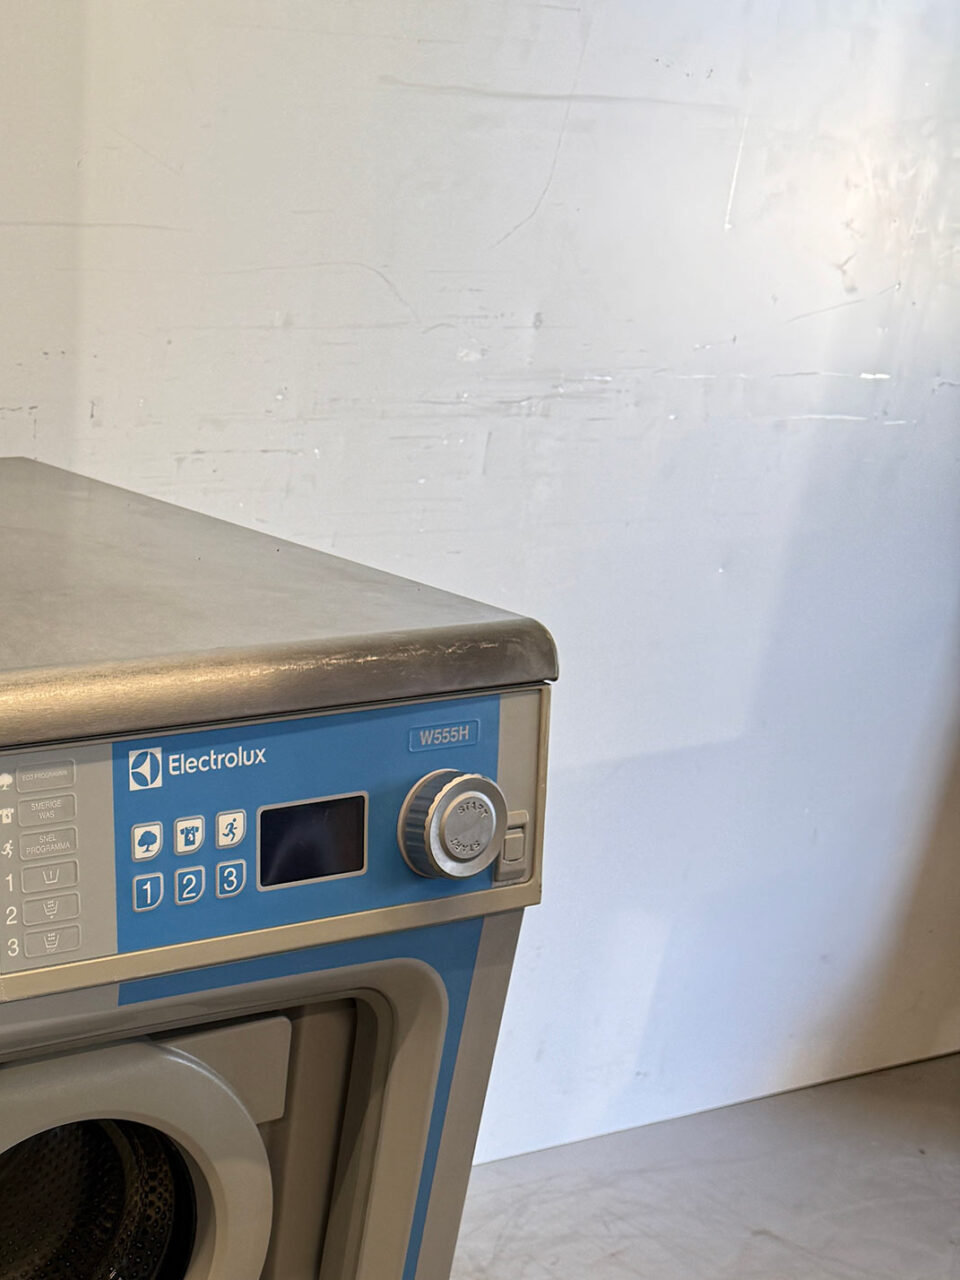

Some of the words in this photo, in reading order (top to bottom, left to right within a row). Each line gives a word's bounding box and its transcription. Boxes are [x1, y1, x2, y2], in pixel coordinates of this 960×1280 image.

[419, 724, 470, 747] W555H
[168, 745, 267, 777] Electrolux
[30, 799, 62, 811] SMERIGE
[457, 800, 489, 818] START
[38, 810, 55, 820] WAS
[25, 841, 71, 855] PROGRAMMA
[39, 834, 57, 844] SNEL
[5, 873, 14, 892] 1
[141, 880, 153, 905] 1
[182, 873, 197, 899] 2
[222, 867, 238, 892] 3
[5, 906, 18, 925] 2
[7, 938, 20, 957] 3
